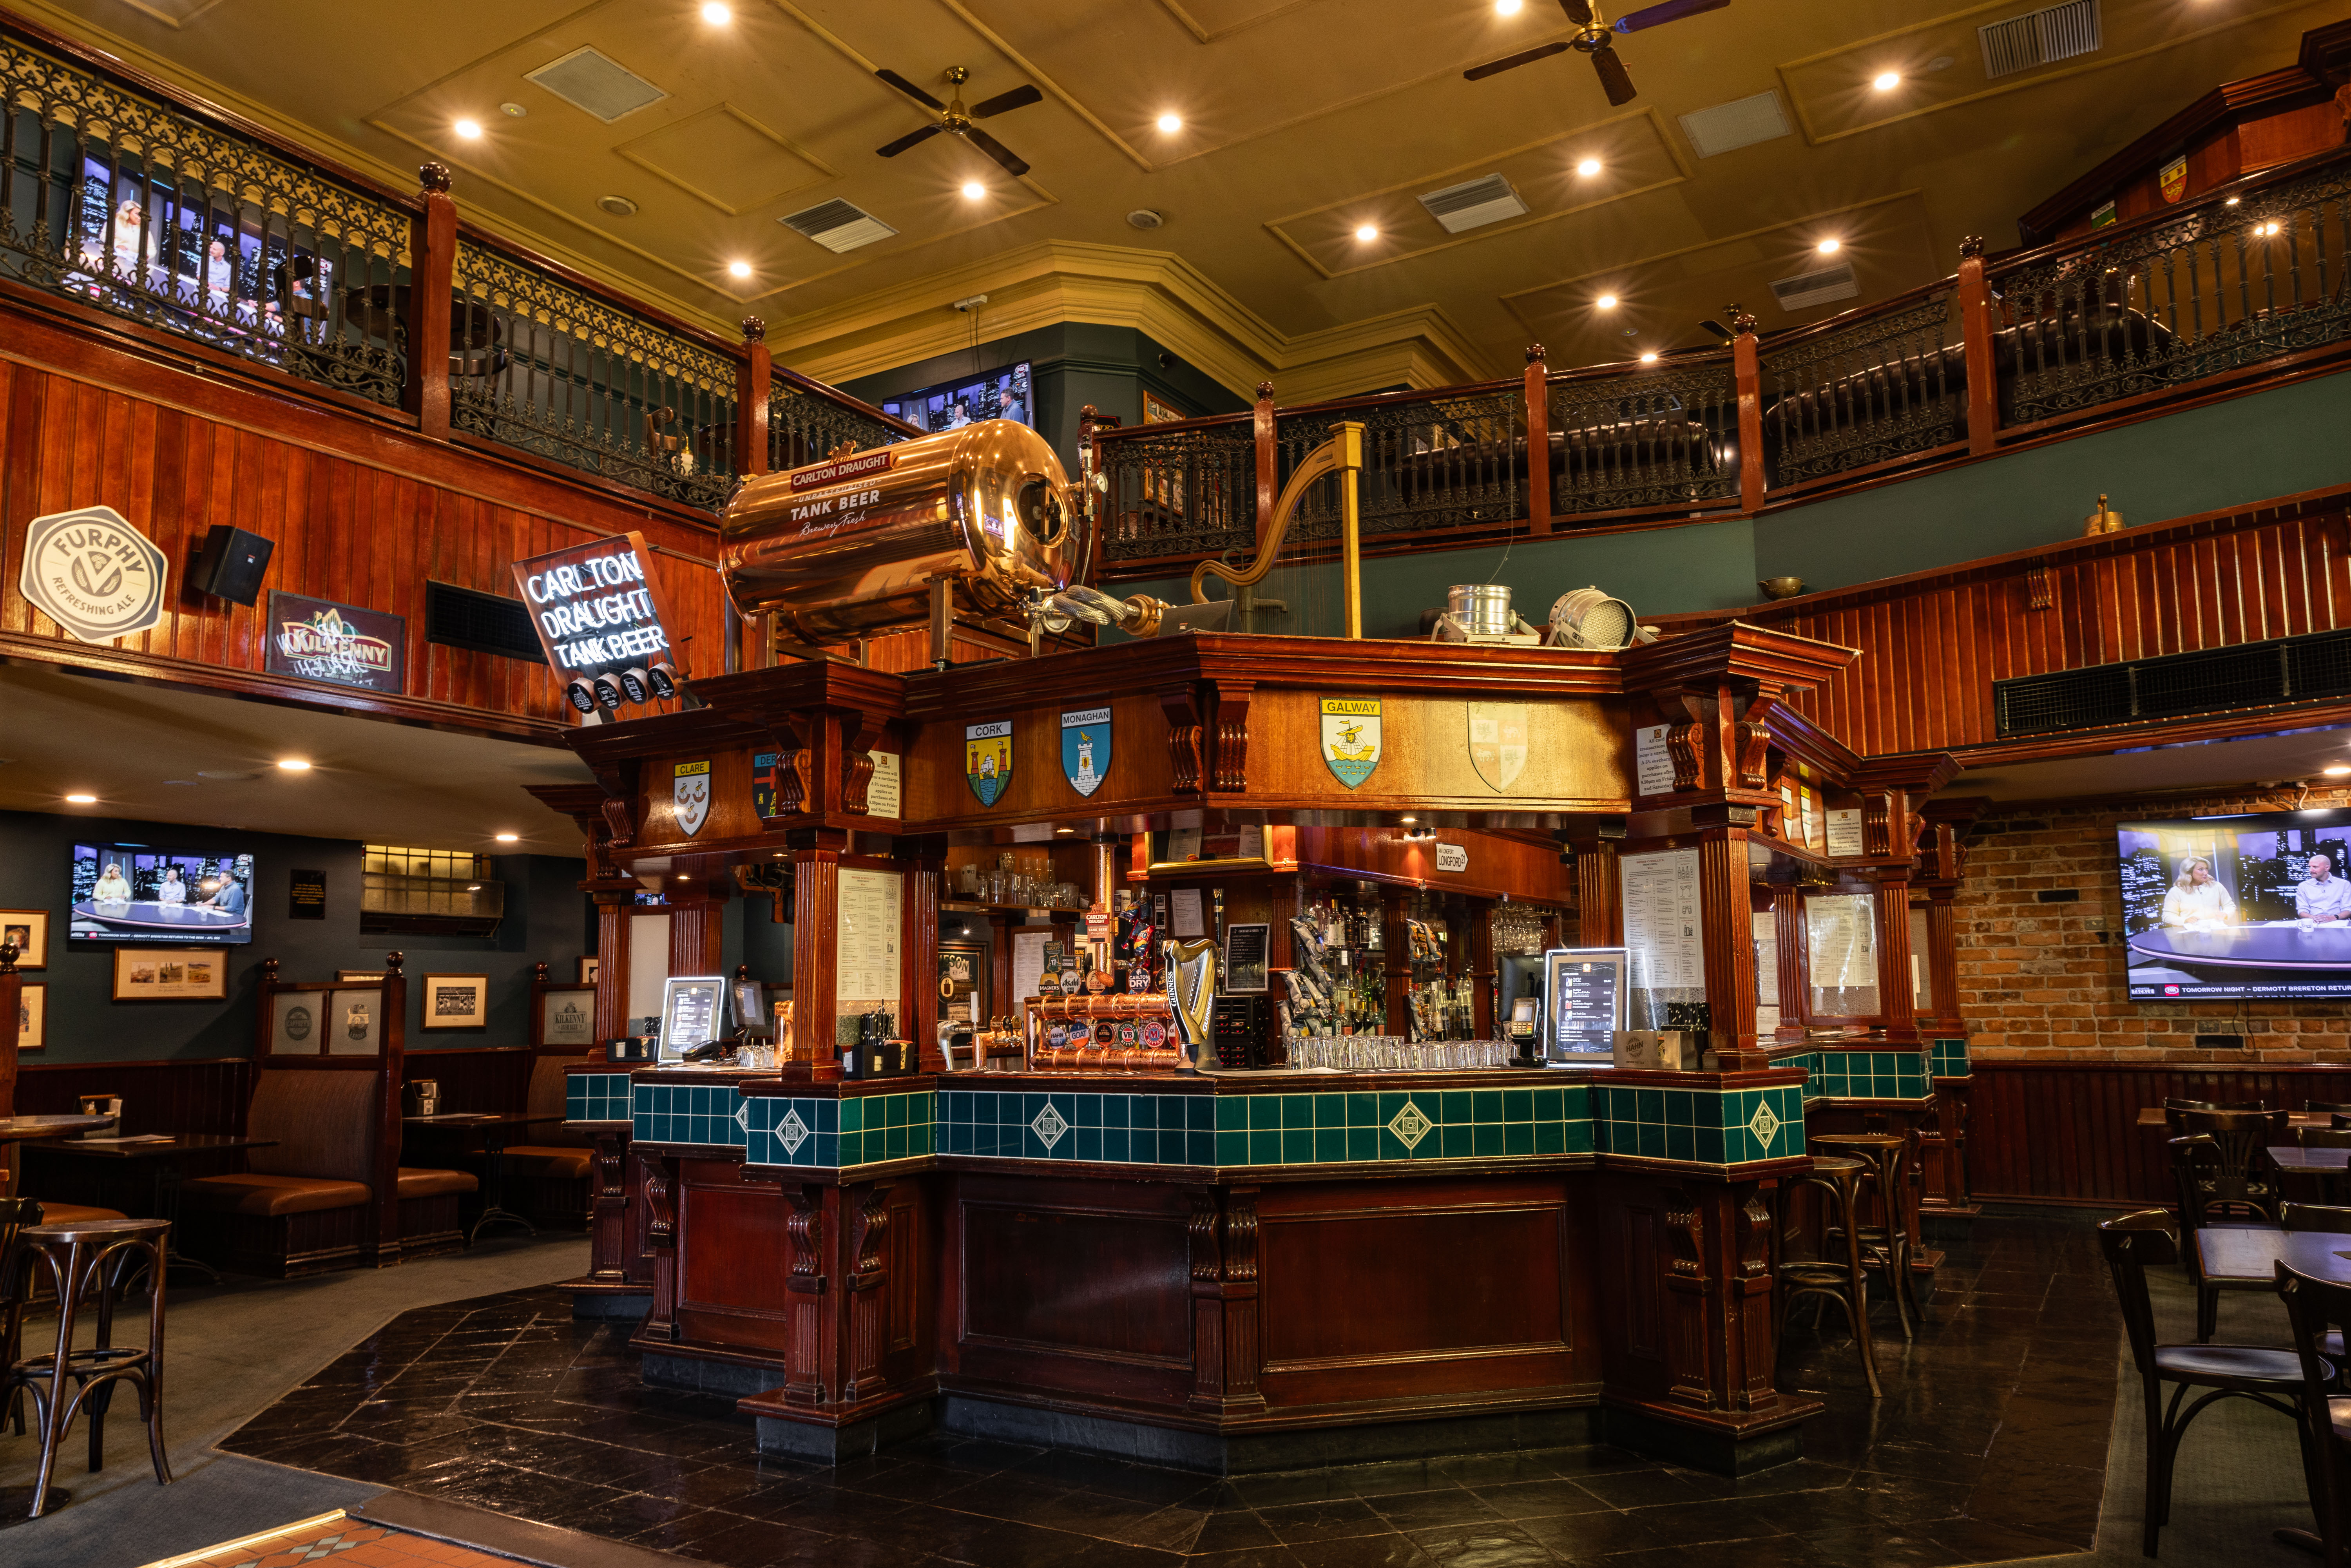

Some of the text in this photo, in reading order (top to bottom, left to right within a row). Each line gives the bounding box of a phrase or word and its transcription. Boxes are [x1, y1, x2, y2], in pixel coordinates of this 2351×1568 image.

[793, 454, 888, 486] CARLTON DRAUGHT
[790, 490, 880, 521] TANK BEER
[799, 510, 866, 538] Brewery Fresh
[53, 529, 145, 572] FURPHY
[528, 550, 644, 603] CARLTON
[53, 577, 135, 615] REFRESHING ALE
[541, 588, 652, 638] DRAUGHT
[293, 628, 386, 664] KILKENNY
[554, 625, 670, 668] TANK BEER
[1327, 702, 1377, 713] GALWAY
[1063, 711, 1109, 725] MONAGHAN
[975, 724, 1003, 737] CORK
[761, 755, 776, 765] DER
[680, 763, 705, 774] CLARE
[1438, 854, 1465, 867] LONGFORD 21
[939, 954, 969, 972] ESON
[1062, 978, 1079, 987] Asahi
[1168, 971, 1176, 1007] GUINNESS
[555, 1014, 585, 1024] KILKENNY
[1202, 992, 1213, 1032] GUINNESS
[1072, 1030, 1087, 1039] GOAT
[1119, 1024, 1137, 1032] VICTORIA
[1146, 1024, 1163, 1036] MELBOURNE
[1627, 1041, 1643, 1052] HAHN
